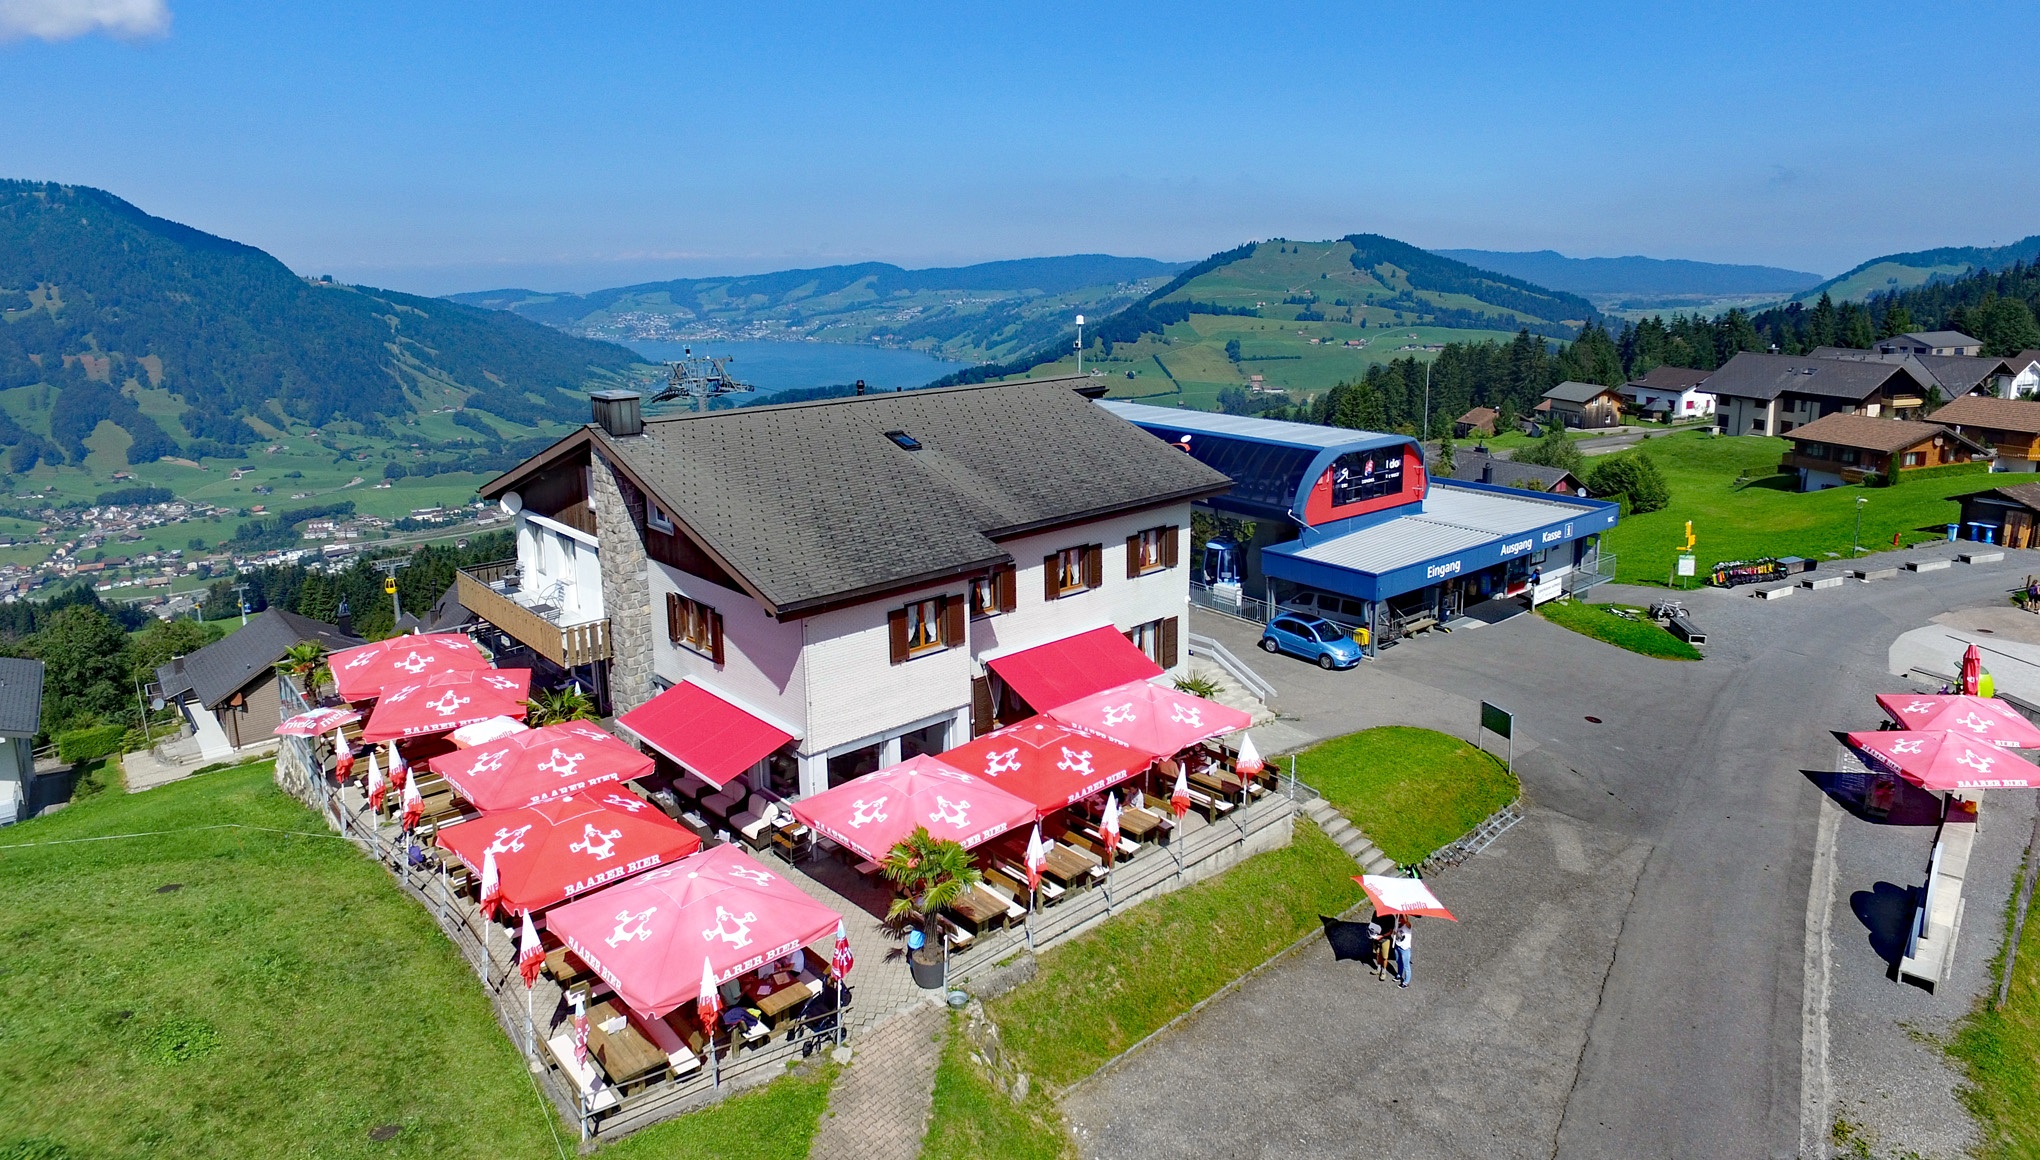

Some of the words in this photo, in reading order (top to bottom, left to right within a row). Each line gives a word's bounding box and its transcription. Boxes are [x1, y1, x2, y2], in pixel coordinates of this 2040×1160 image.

[1542, 530, 1562, 543] Kasse
[1500, 538, 1533, 556] Ausgang
[1427, 560, 1461, 578] Eingang
[284, 719, 317, 730] rivella
[320, 709, 351, 728] rivella
[403, 721, 457, 735] BAARER
[1067, 779, 1105, 803] BAARER
[1106, 769, 1127, 785] BIER
[564, 866, 625, 897] BAARER
[627, 854, 661, 873] BIER
[568, 935, 601, 973] BAARER
[711, 956, 763, 983] AARER
[766, 939, 800, 964] BIER
